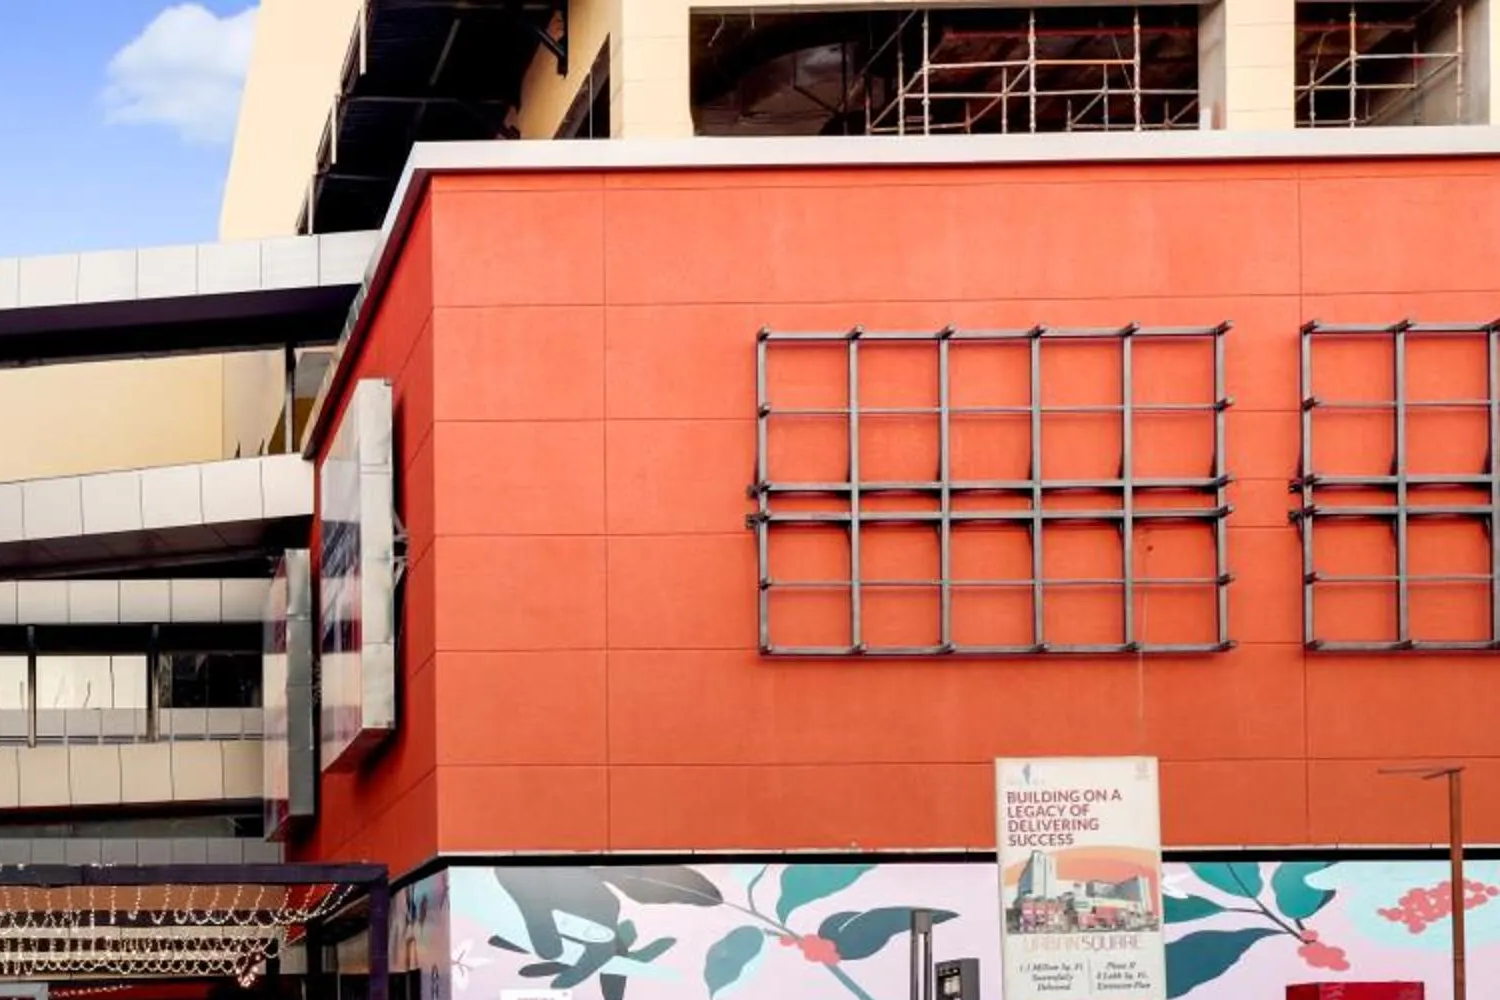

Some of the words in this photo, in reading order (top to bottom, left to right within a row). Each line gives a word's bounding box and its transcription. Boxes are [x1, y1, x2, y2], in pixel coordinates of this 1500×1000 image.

[1006, 790, 1080, 804] BUILDING
[1083, 789, 1108, 802] ON
[1111, 788, 1123, 801] A
[1007, 804, 1066, 819] LEGACY
[1069, 803, 1091, 817] OF
[1007, 817, 1100, 833] DELIVERING
[1008, 832, 1075, 847] SUCCESS
